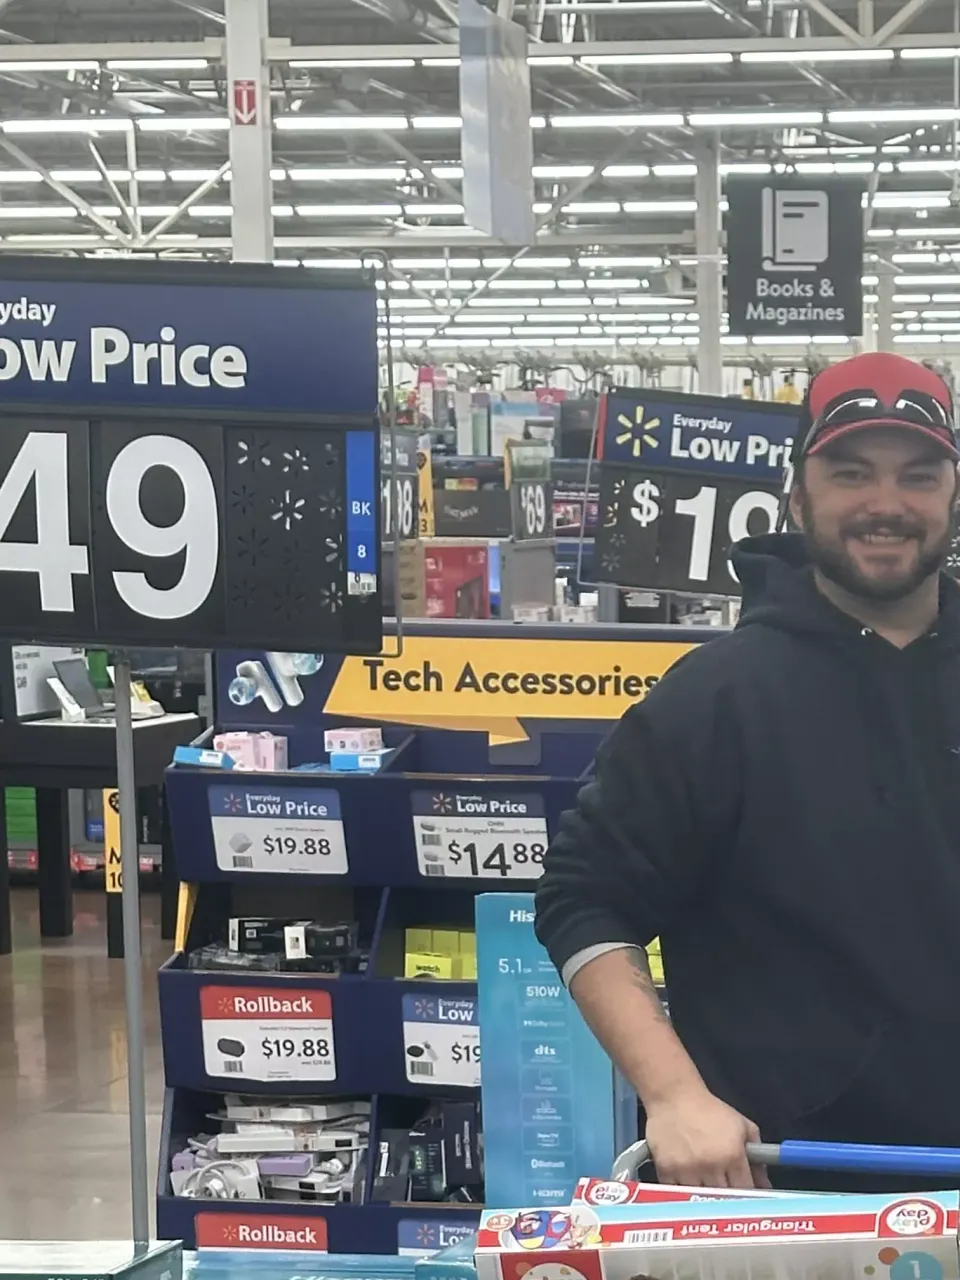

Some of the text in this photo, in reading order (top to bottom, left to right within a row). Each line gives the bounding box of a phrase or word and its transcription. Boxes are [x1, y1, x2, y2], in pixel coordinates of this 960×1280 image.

[757, 278, 835, 296] Books &
[0, 297, 56, 326] yday
[746, 302, 845, 325] Magazines
[90, 326, 248, 388] Price
[672, 414, 733, 434] Everyday
[671, 427, 794, 468] Low Pri
[352, 502, 371, 516] BK
[521, 484, 545, 535] $69
[0, 431, 219, 620] 49
[358, 545, 366, 558] 8
[363, 660, 661, 698] Tech Accessories
[246, 800, 329, 816] Low Price
[457, 801, 527, 813] Low Price
[263, 834, 331, 856] $19.88
[526, 986, 560, 998] 510W
[234, 996, 314, 1014] Rollback
[438, 999, 475, 1009] Everyday
[438, 1006, 475, 1022] Low
[261, 1037, 330, 1060] $19.88
[534, 1044, 557, 1056] dts
[595, 1191, 621, 1203] day
[238, 1224, 318, 1245] Rollback
[680, 1219, 816, 1236] Triangular Tent
[440, 1232, 464, 1247] Lo
[909, 1260, 921, 1279] 1
